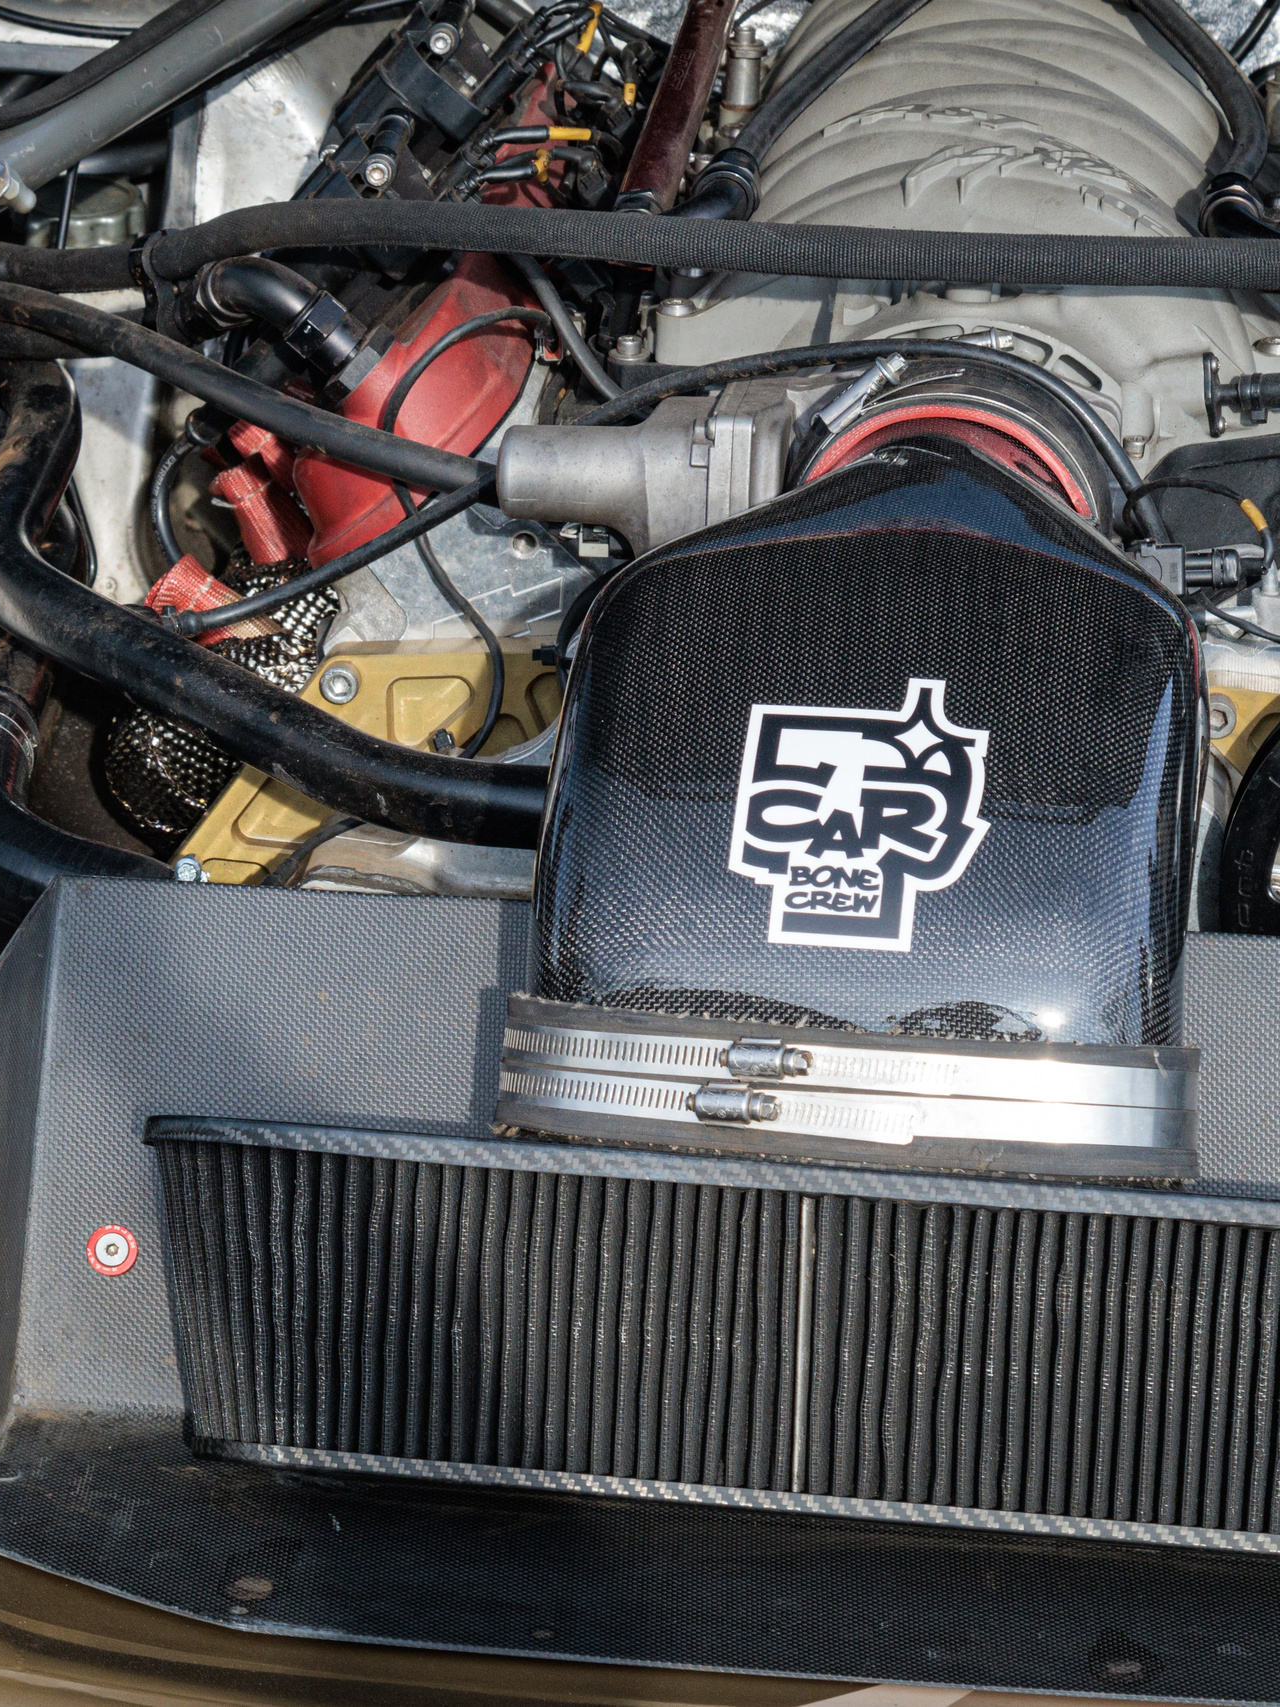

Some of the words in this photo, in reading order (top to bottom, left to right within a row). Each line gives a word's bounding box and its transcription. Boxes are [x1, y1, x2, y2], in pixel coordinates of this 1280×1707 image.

[745, 787, 939, 859] CAR
[789, 865, 880, 891] BONE
[784, 890, 880, 913] CREW
